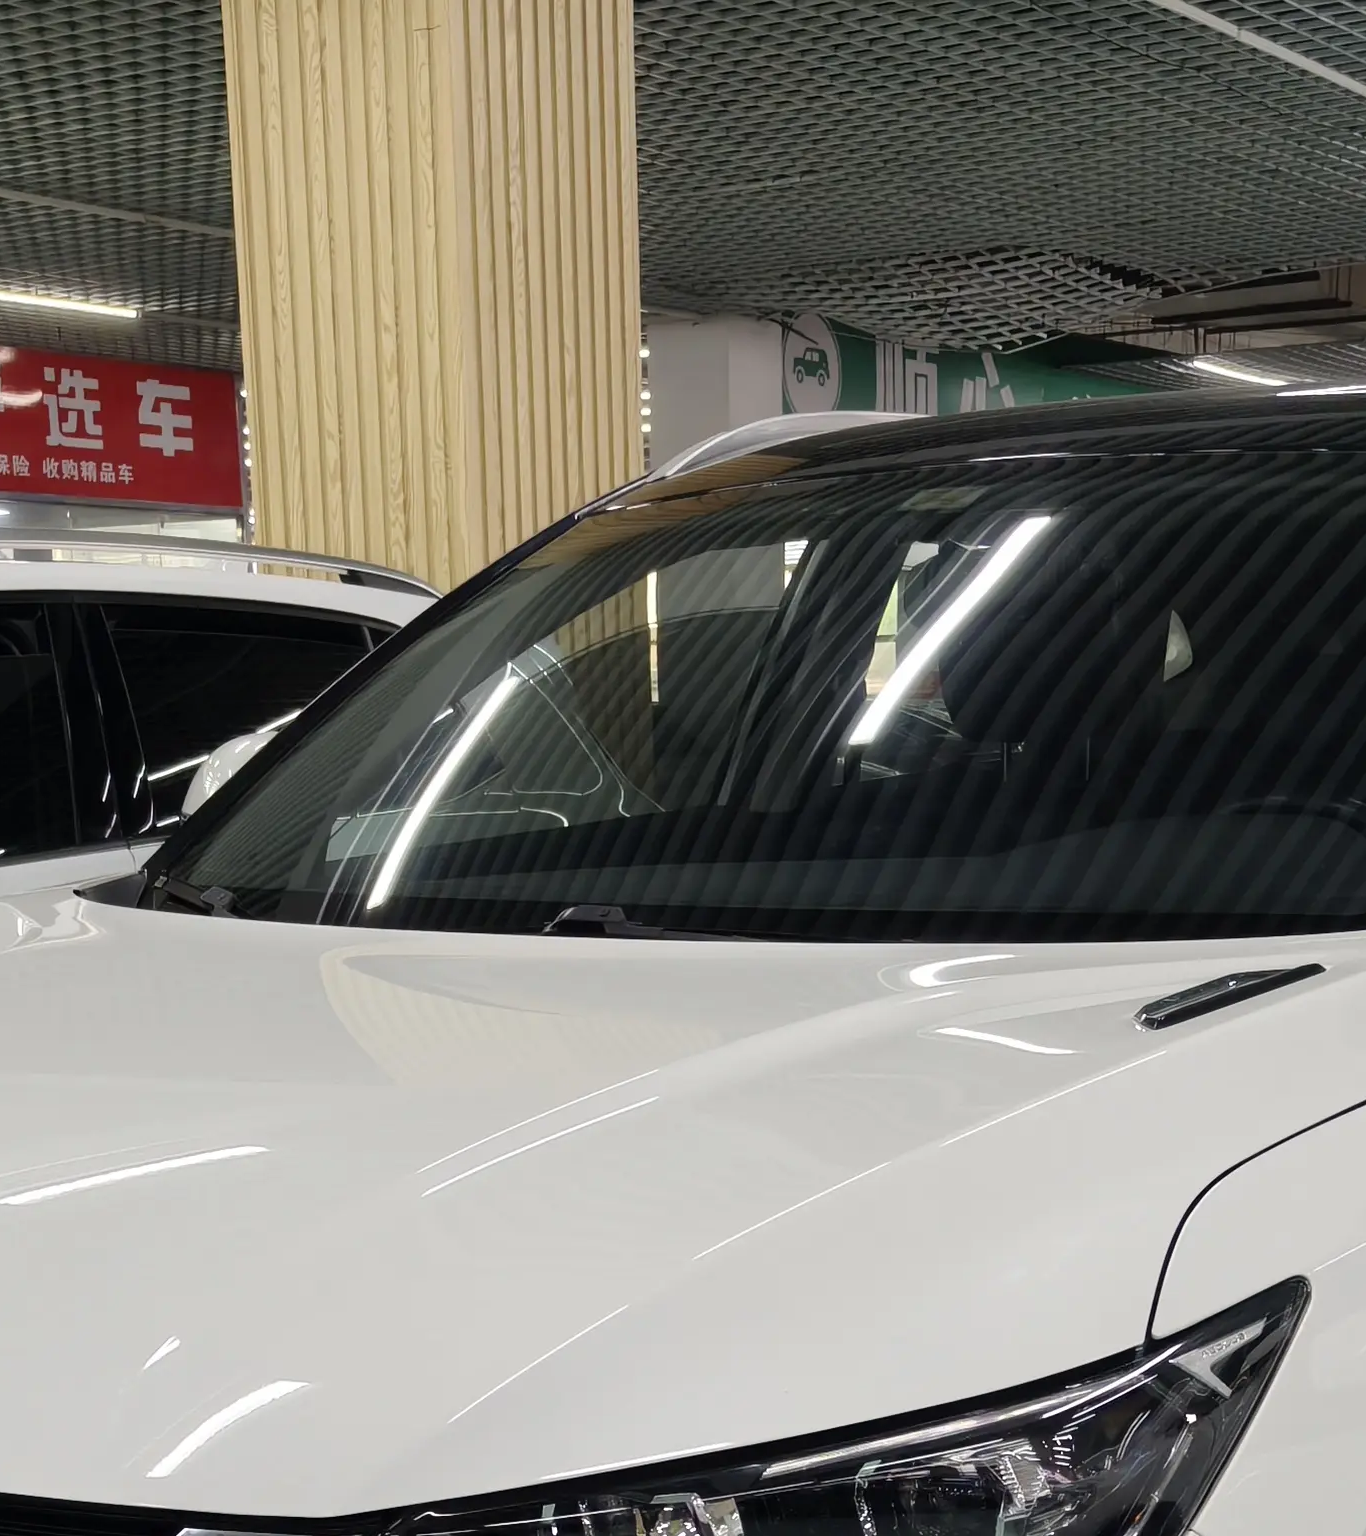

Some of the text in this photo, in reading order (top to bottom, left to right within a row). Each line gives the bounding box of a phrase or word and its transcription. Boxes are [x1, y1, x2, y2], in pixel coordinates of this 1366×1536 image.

[42, 456, 135, 485] 收购精品车
